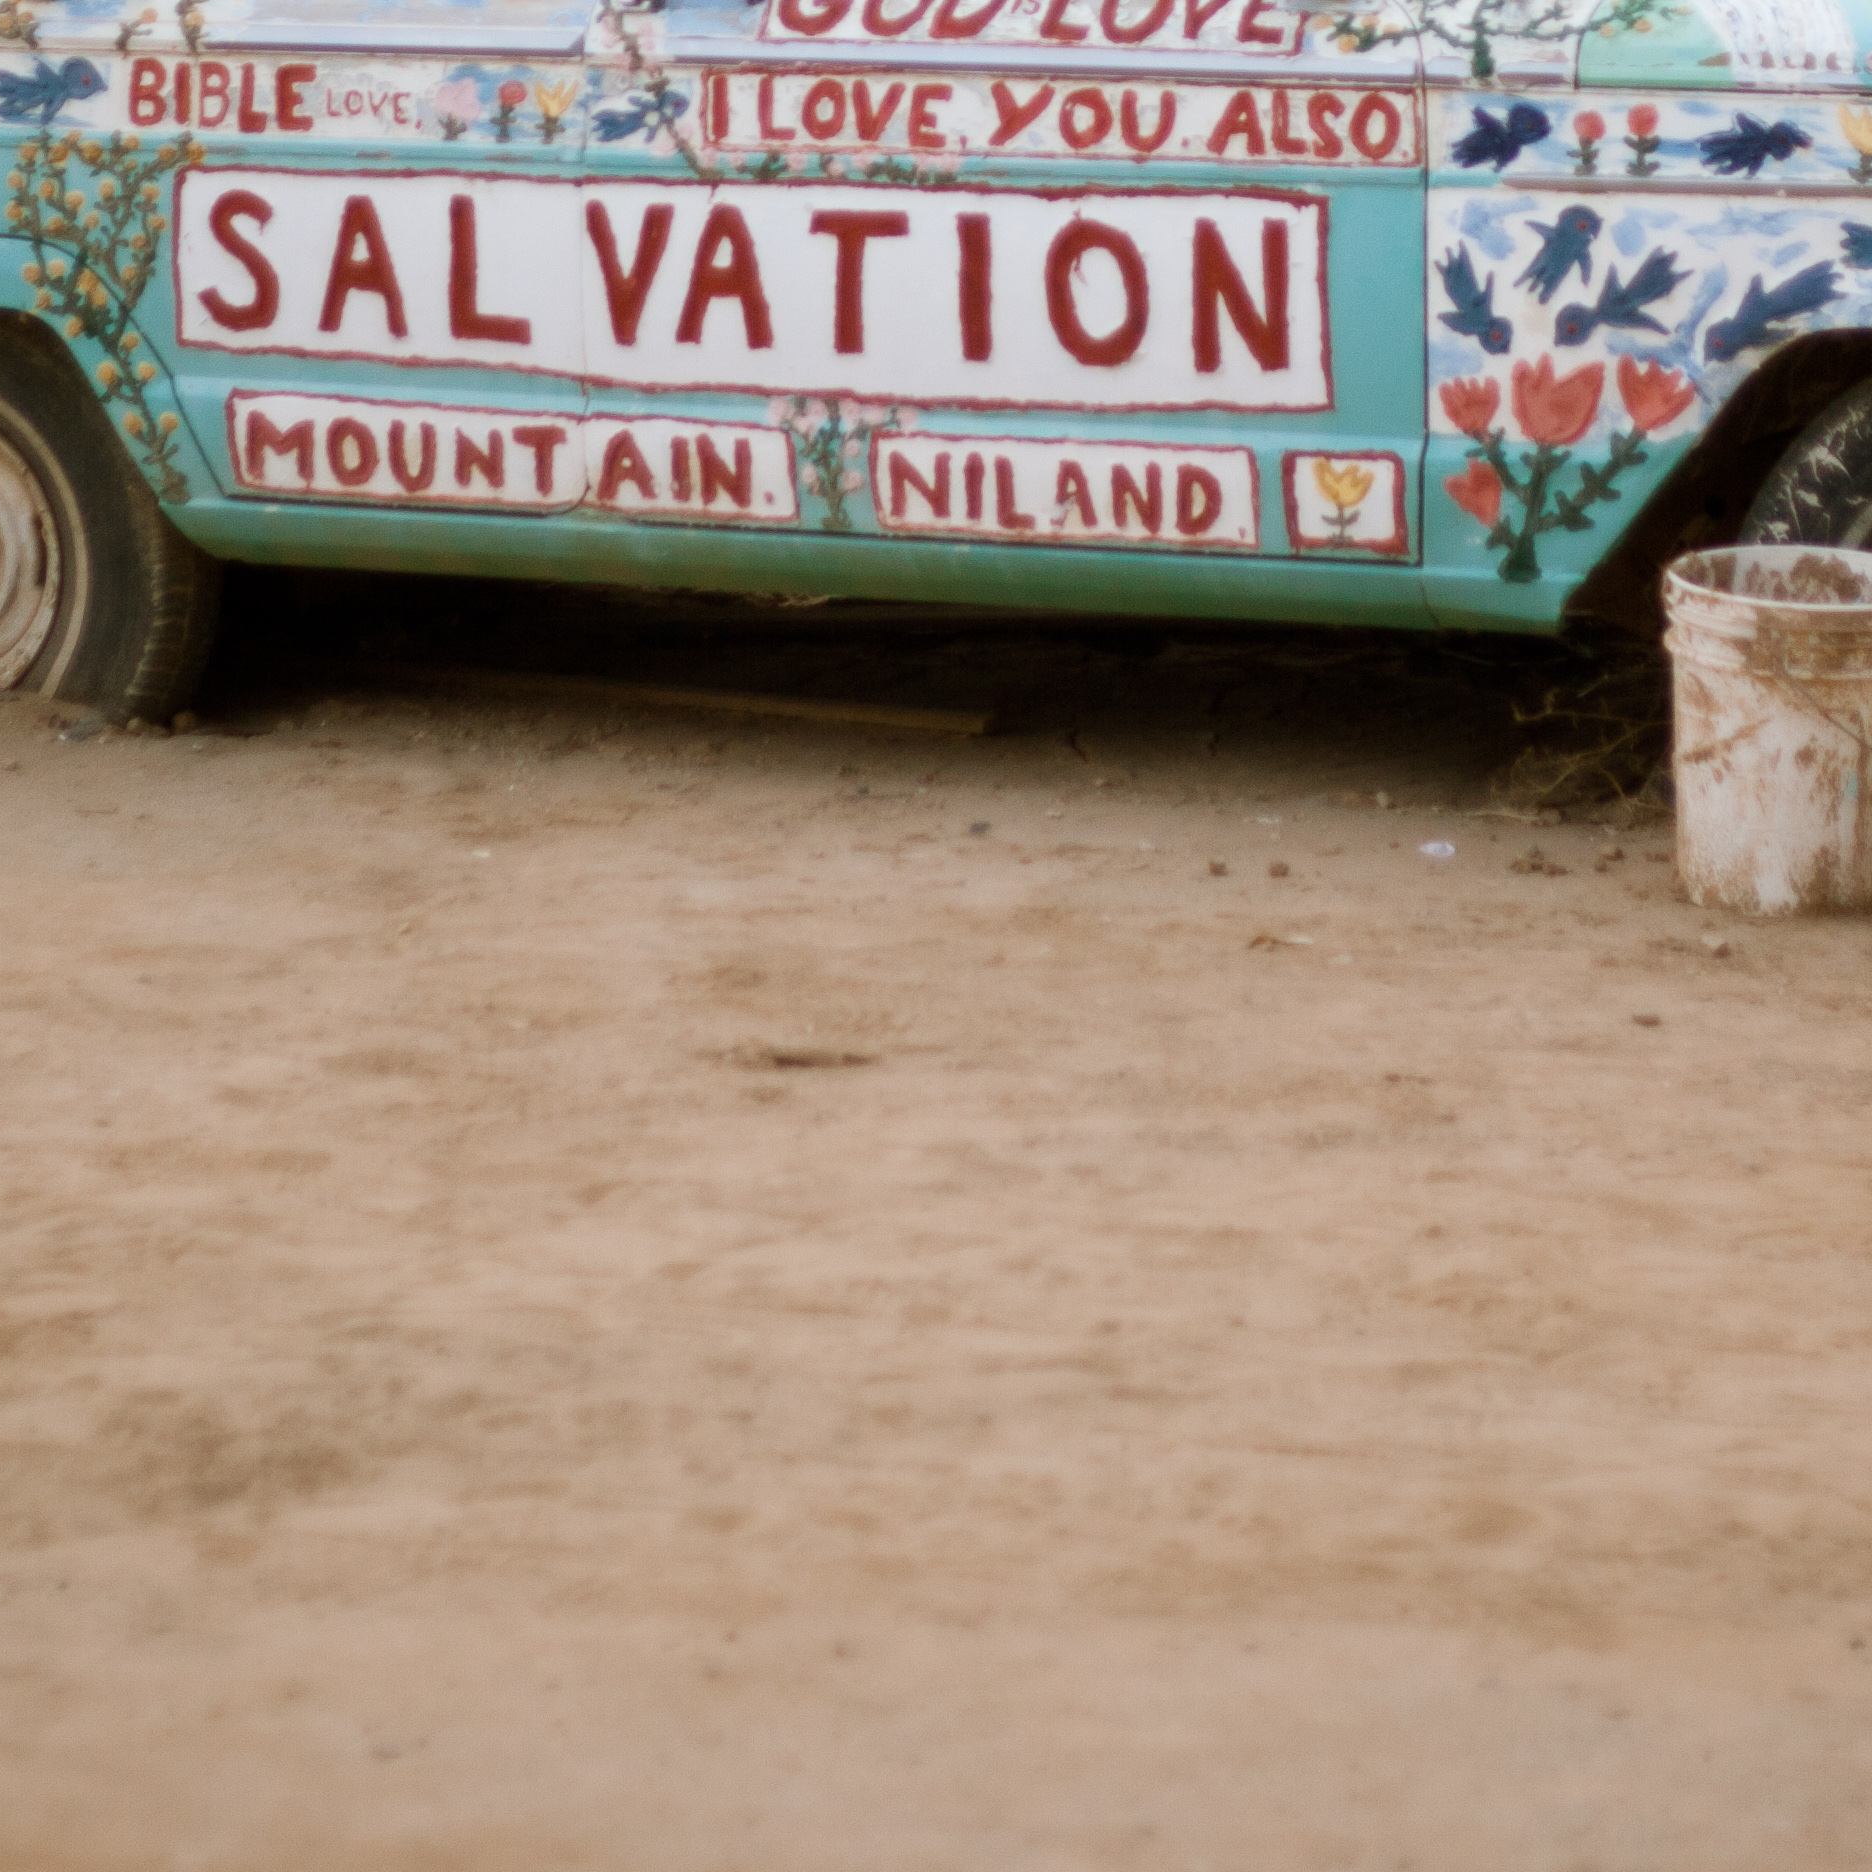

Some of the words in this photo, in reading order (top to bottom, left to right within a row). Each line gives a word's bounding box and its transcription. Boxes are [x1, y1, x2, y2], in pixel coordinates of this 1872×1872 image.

[128, 57, 318, 133] BIBLE
[709, 71, 728, 143] I
[758, 77, 955, 150] LOVE
[196, 189, 1290, 373] SALVATION
